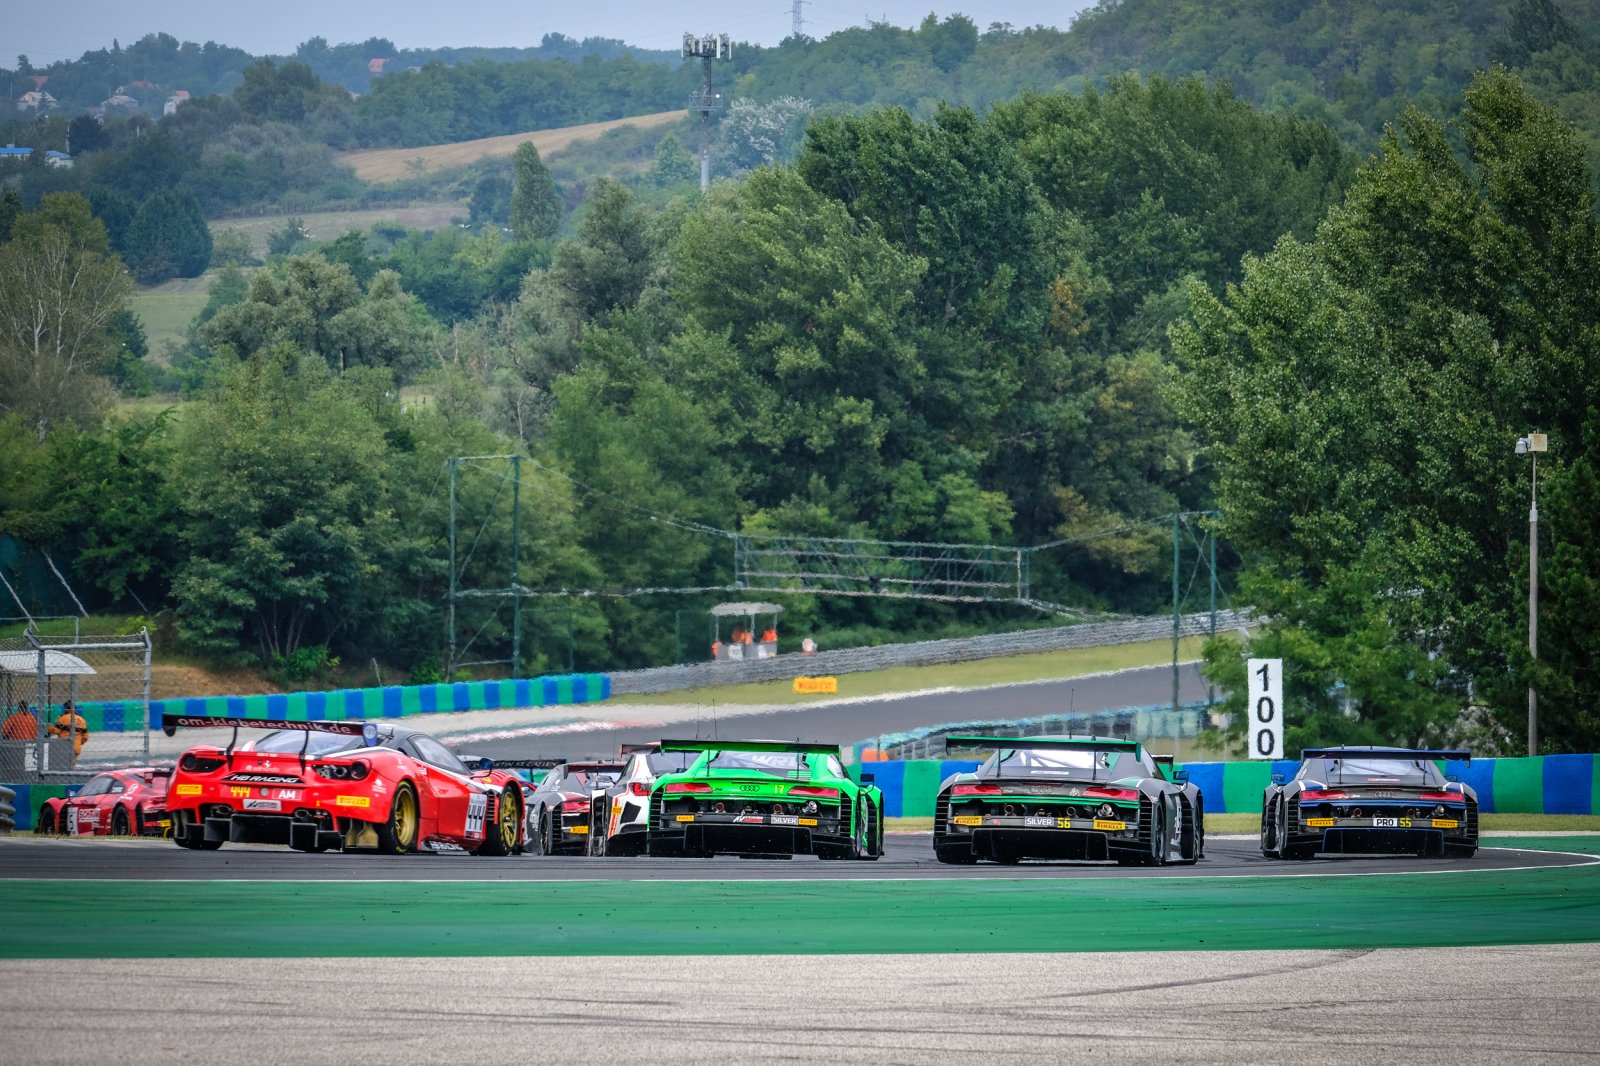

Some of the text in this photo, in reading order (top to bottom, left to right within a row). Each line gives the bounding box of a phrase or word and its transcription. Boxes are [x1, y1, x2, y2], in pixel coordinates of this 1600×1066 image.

[1256, 663, 1275, 756] 100
[177, 716, 352, 735] om-klebetechnik.de
[249, 775, 300, 783] RACING
[230, 785, 297, 799] 444 AM
[773, 784, 785, 795] 17
[1026, 817, 1071, 829] SILVER 56
[1376, 818, 1412, 828] PRO 55
